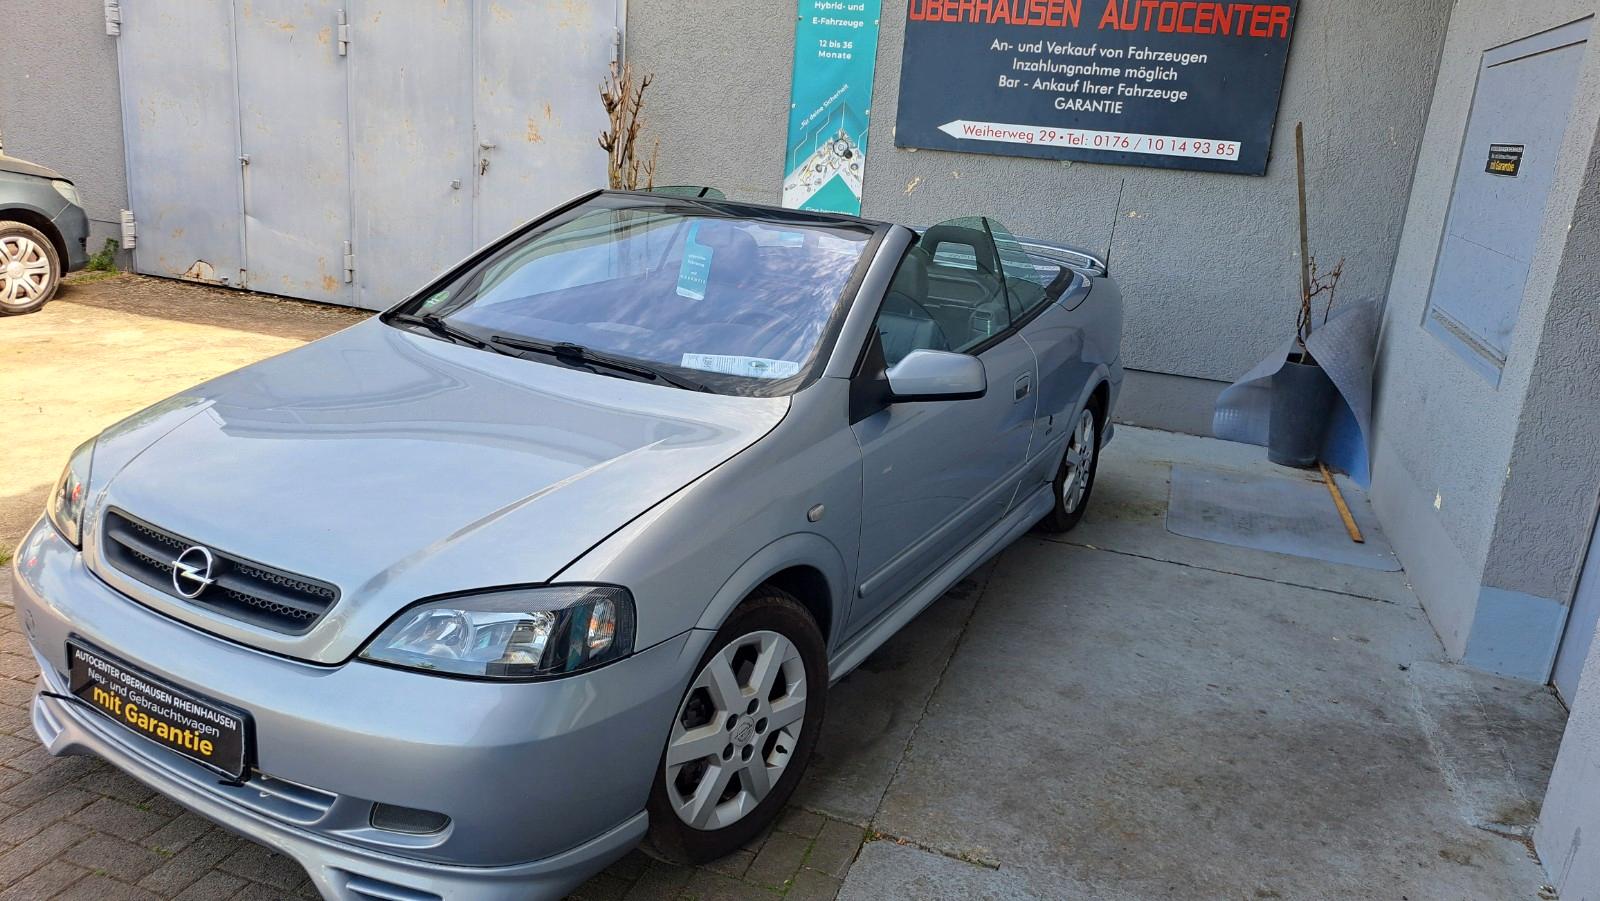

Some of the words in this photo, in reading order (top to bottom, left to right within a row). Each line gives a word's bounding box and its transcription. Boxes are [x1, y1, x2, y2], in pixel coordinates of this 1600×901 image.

[814, 1, 846, 10] Hybrid-
[909, 0, 1082, 28] OBERHAUSEN
[1098, 0, 1290, 38] AUTOCENTER
[812, 17, 864, 29] E-Fahrzeuge
[818, 50, 852, 60] Monate
[819, 39, 828, 48] 12
[829, 40, 841, 48] bis
[842, 41, 853, 49] 36
[990, 38, 1014, 52] An-
[1018, 40, 1043, 53] und
[1046, 41, 1098, 57] Verkauf
[1099, 48, 1123, 58] von
[1127, 46, 1208, 66] Fahrzeugen
[1012, 57, 1121, 77] Inzahlungnahme
[1124, 66, 1178, 82] möglich
[998, 75, 1020, 88] Bar
[1032, 77, 1080, 93] Ankauf
[1082, 80, 1115, 95] Ihrer
[1117, 83, 1188, 103] Fahrzeuge
[1054, 97, 1123, 114] GARANTIE
[963, 124, 1034, 143] Weiherweg
[1039, 130, 1056, 142] 29
[1067, 133, 1088, 145] Tel:
[1094, 135, 1129, 148] 0176
[1147, 138, 1164, 150] 10
[1171, 139, 1187, 152] 14
[1193, 141, 1210, 154] 93
[1216, 143, 1235, 156] 85
[75, 649, 120, 680] AUTOCENTER
[120, 672, 172, 704] OBERHAUSEN
[173, 697, 237, 731] RHEINHAUSEN
[88, 668, 108, 684] Neu-
[109, 681, 127, 697] und
[129, 690, 220, 738] Gebrauchtwagen
[93, 686, 121, 715] mit
[124, 702, 214, 756] Garantie
